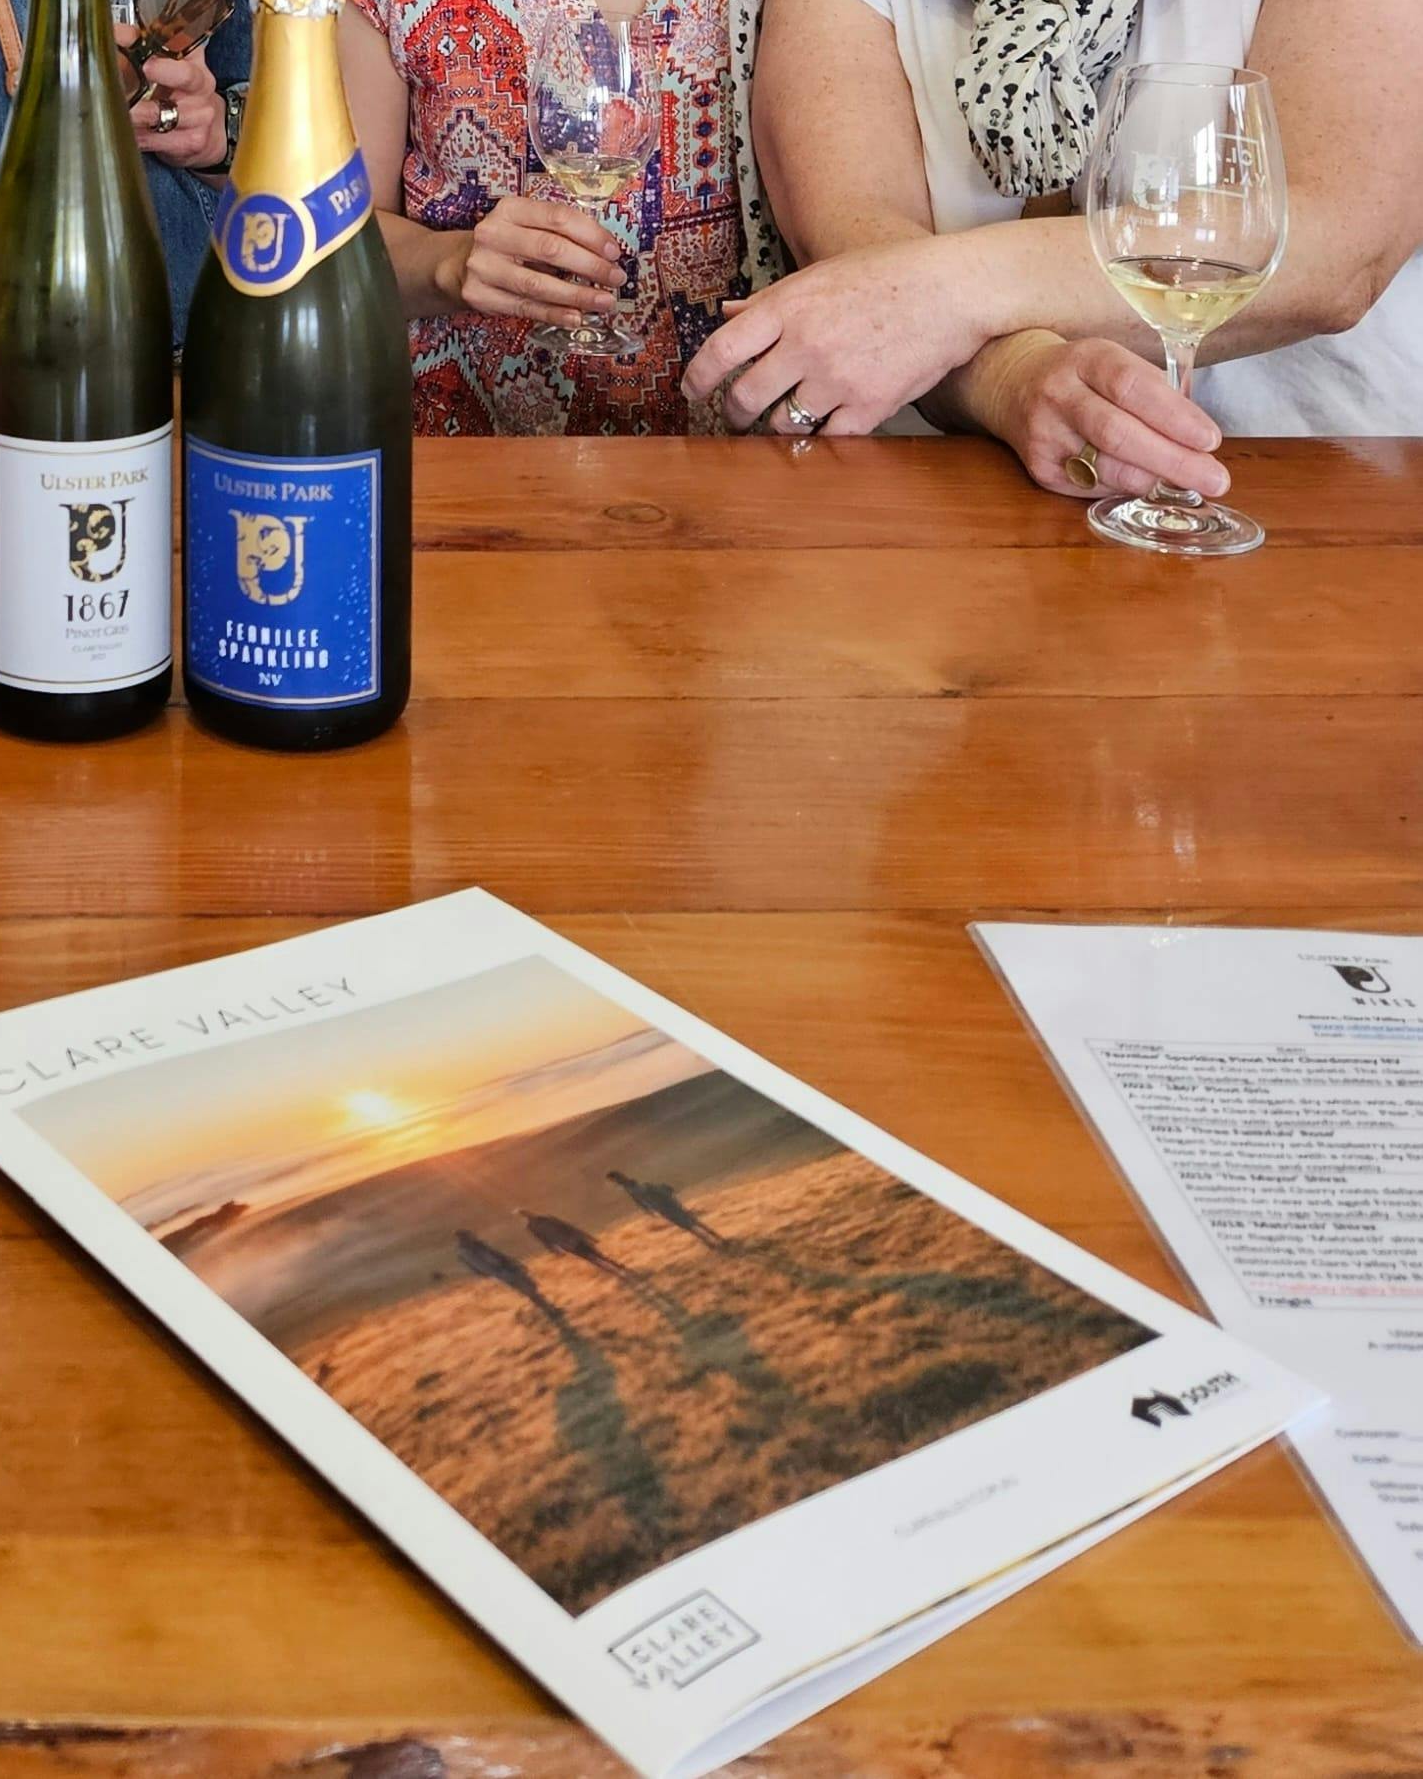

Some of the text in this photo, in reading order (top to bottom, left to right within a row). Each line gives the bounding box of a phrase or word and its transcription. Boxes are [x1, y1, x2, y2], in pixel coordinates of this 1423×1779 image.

[40, 468, 150, 491] ULSTER PARK
[214, 472, 333, 502] ULSTER PARK
[63, 589, 130, 622] 1867
[65, 627, 102, 639] PINOT
[218, 639, 330, 669] SPARKLING
[258, 672, 282, 686] NV
[175, 975, 361, 1037] VALLEY
[631, 1605, 718, 1663] CLARE
[633, 1623, 738, 1690] VALLEY
